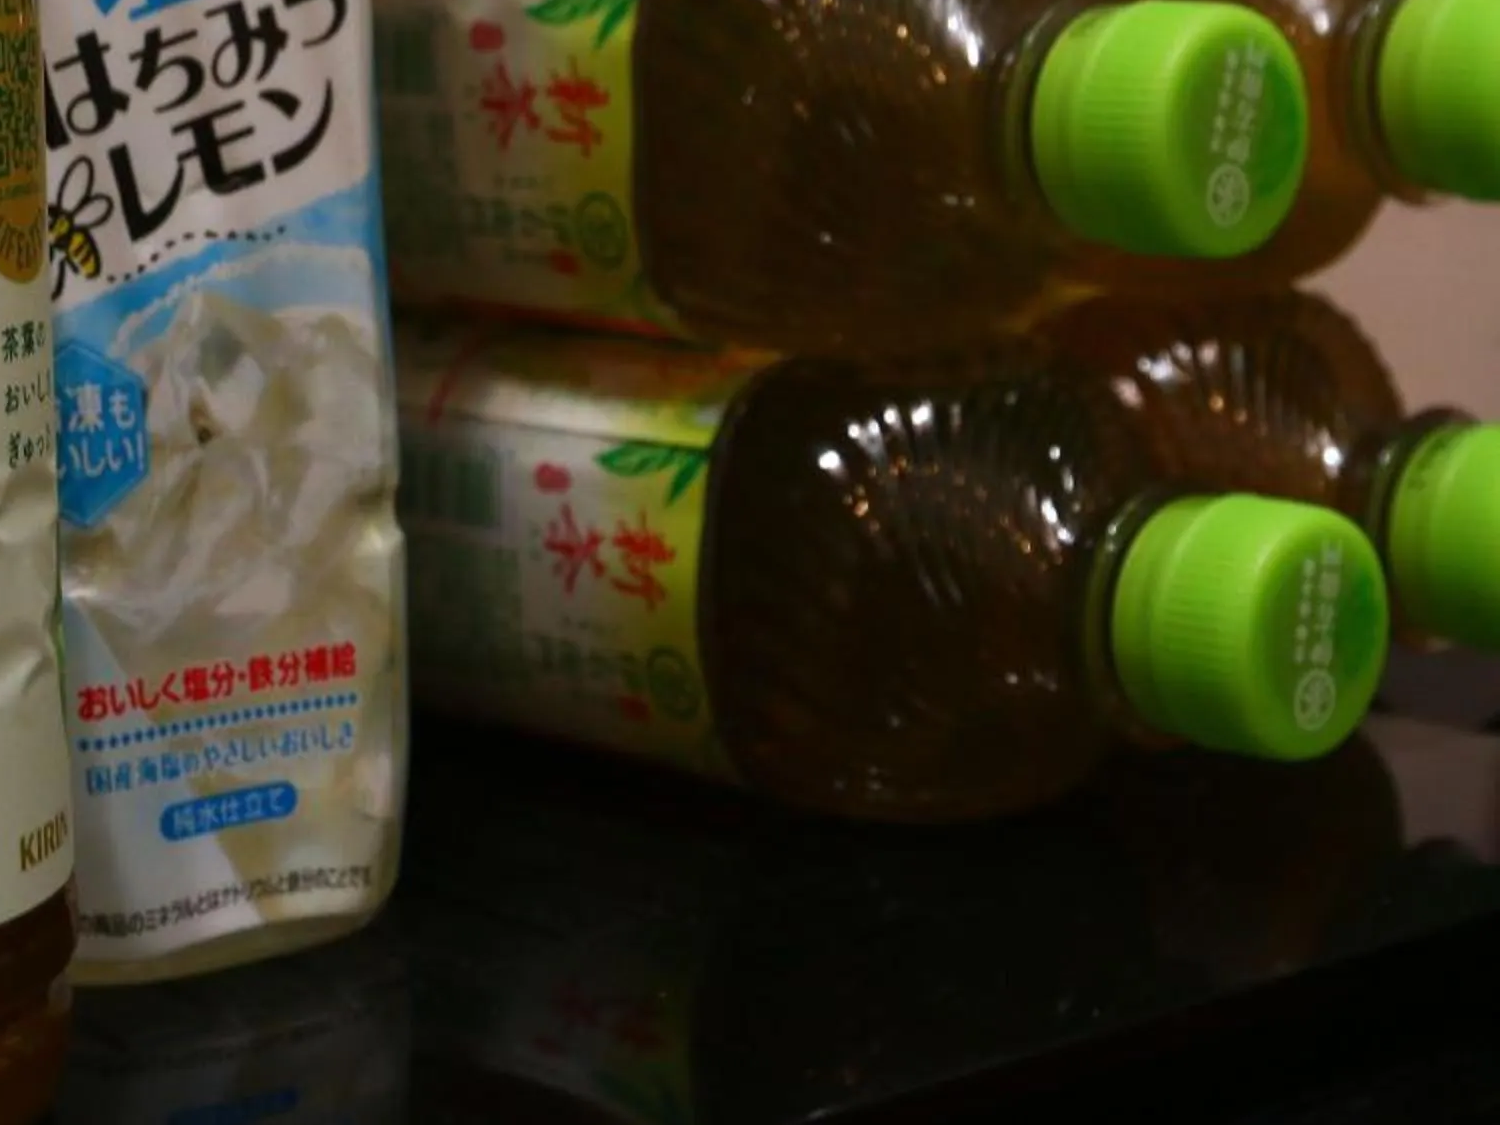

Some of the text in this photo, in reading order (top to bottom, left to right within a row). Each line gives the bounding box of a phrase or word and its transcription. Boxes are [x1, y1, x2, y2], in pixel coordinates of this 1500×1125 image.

[109, 78, 333, 242] レモン
[55, 381, 136, 433] 凍も
[77, 641, 357, 722] おいしく塩分・鉄分補給
